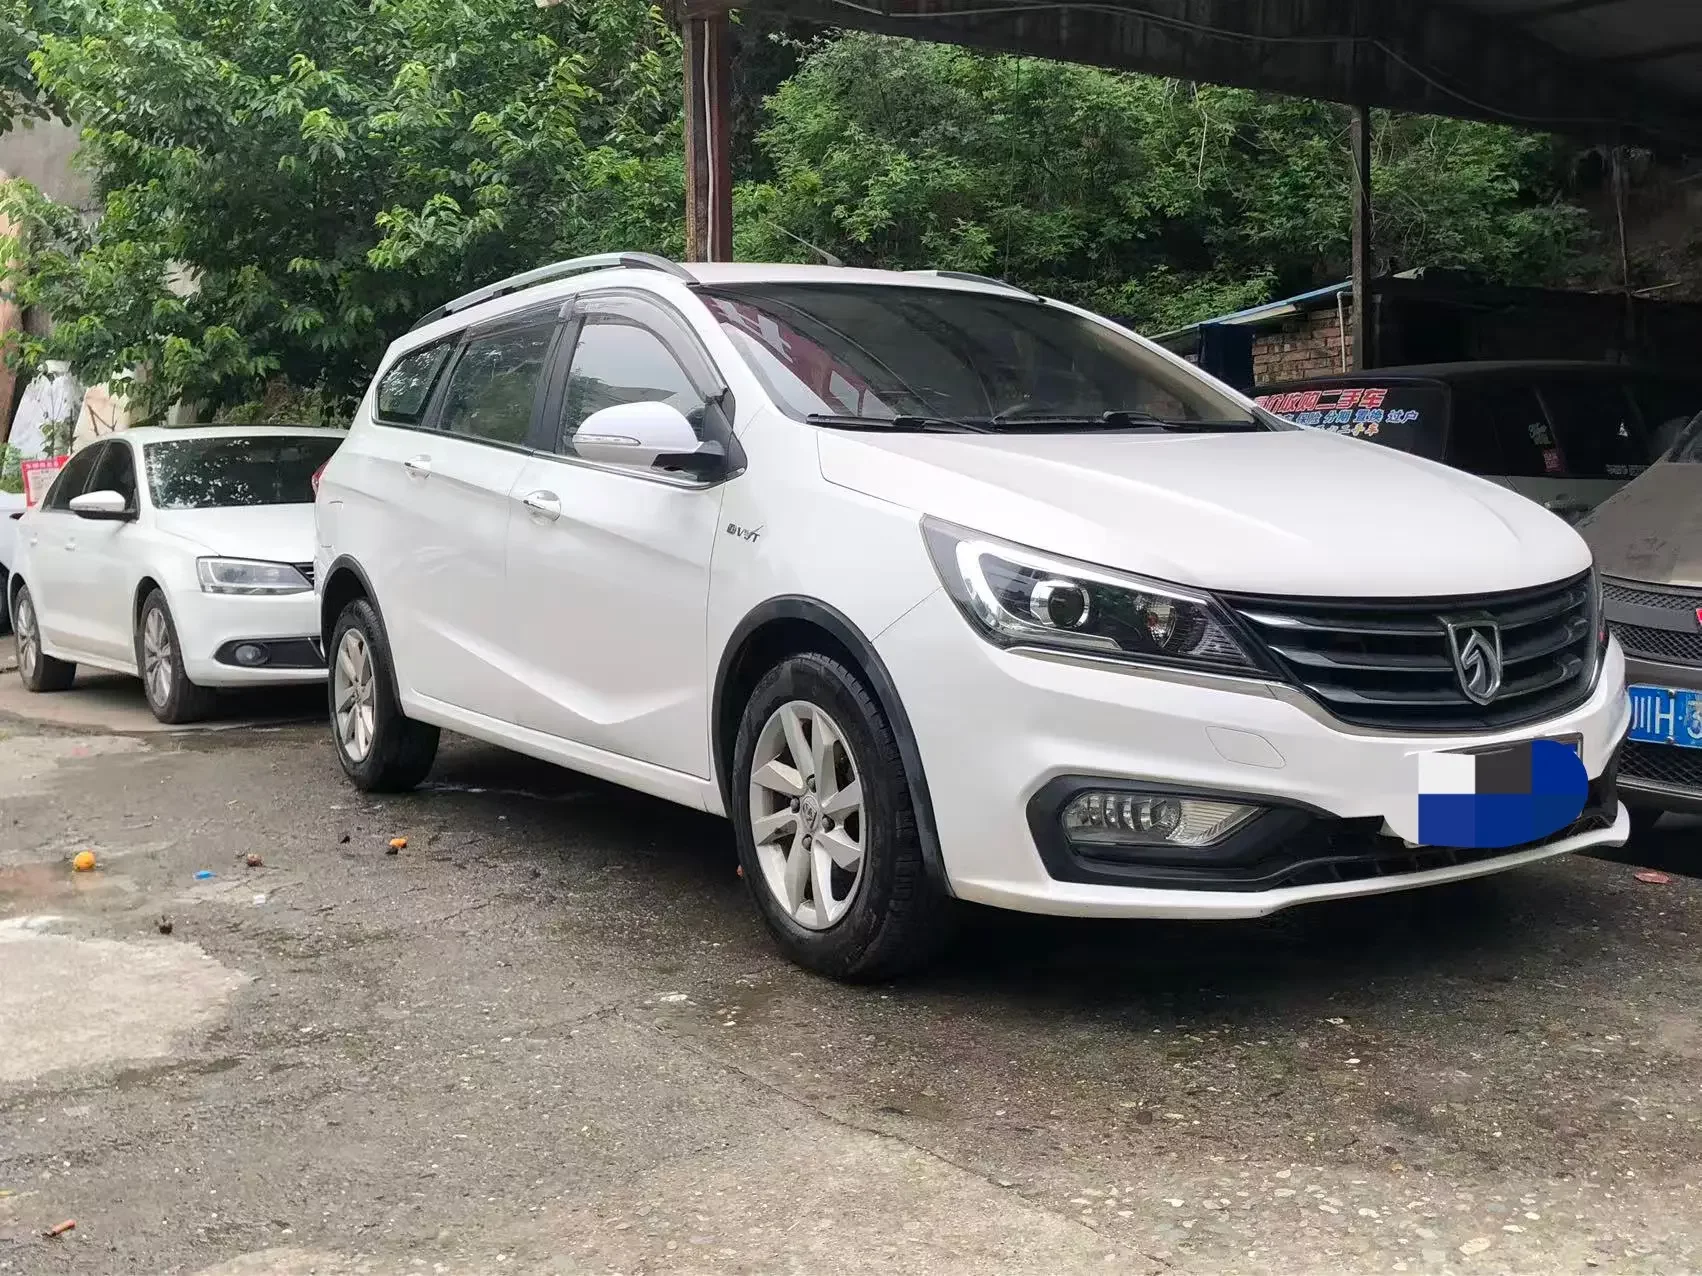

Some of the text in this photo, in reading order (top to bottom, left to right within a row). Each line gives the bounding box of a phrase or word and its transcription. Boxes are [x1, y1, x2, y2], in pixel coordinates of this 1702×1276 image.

[1323, 409, 1353, 424] 分期
[1353, 408, 1385, 424] 置换
[1385, 408, 1419, 424] 过户
